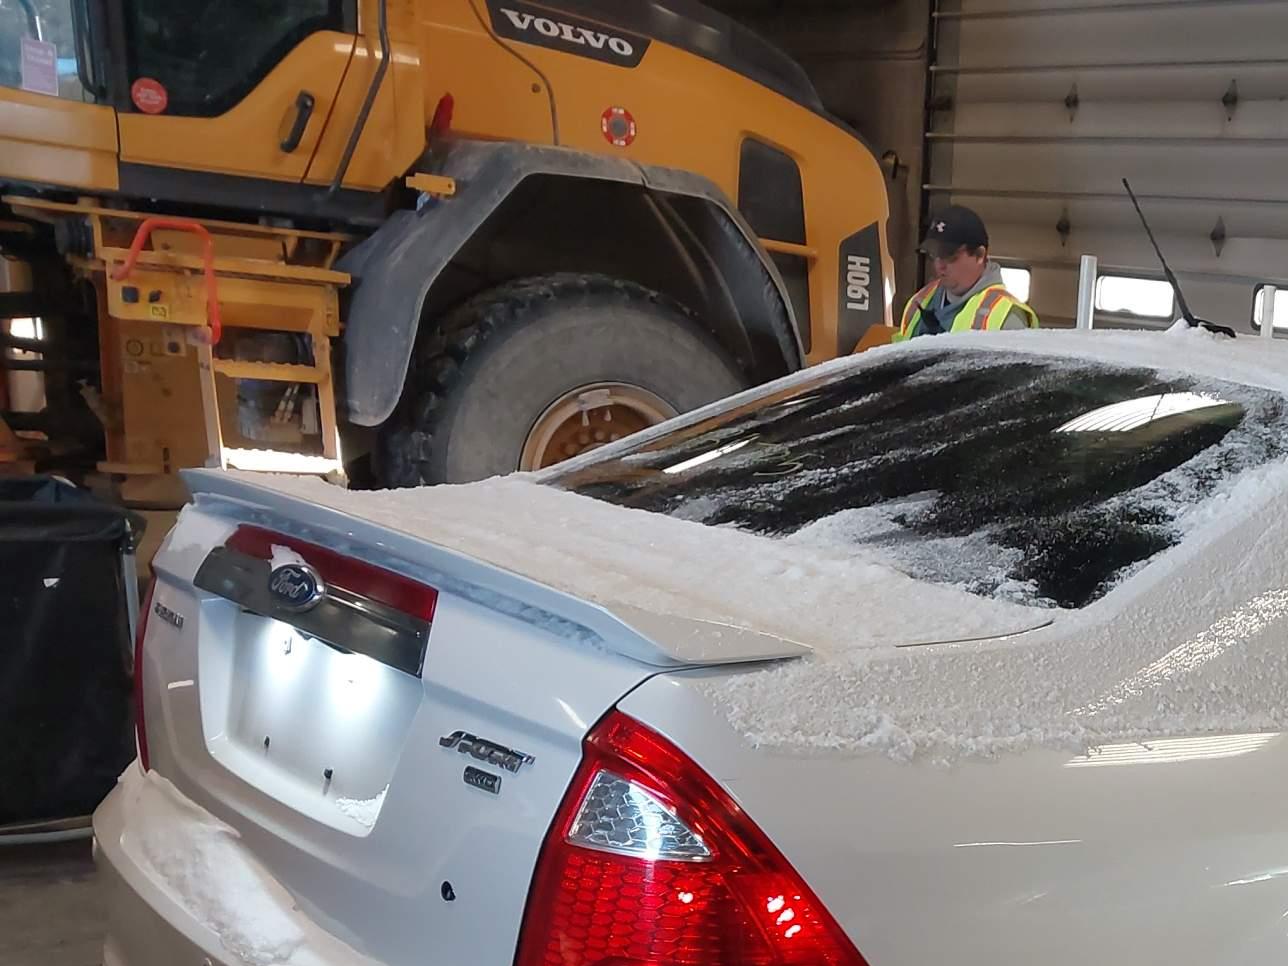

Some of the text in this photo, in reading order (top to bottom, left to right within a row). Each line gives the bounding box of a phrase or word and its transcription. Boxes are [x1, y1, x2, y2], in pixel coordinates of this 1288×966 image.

[500, 8, 633, 56] VOLVO
[846, 255, 871, 311] L90H
[270, 567, 309, 599] Ford
